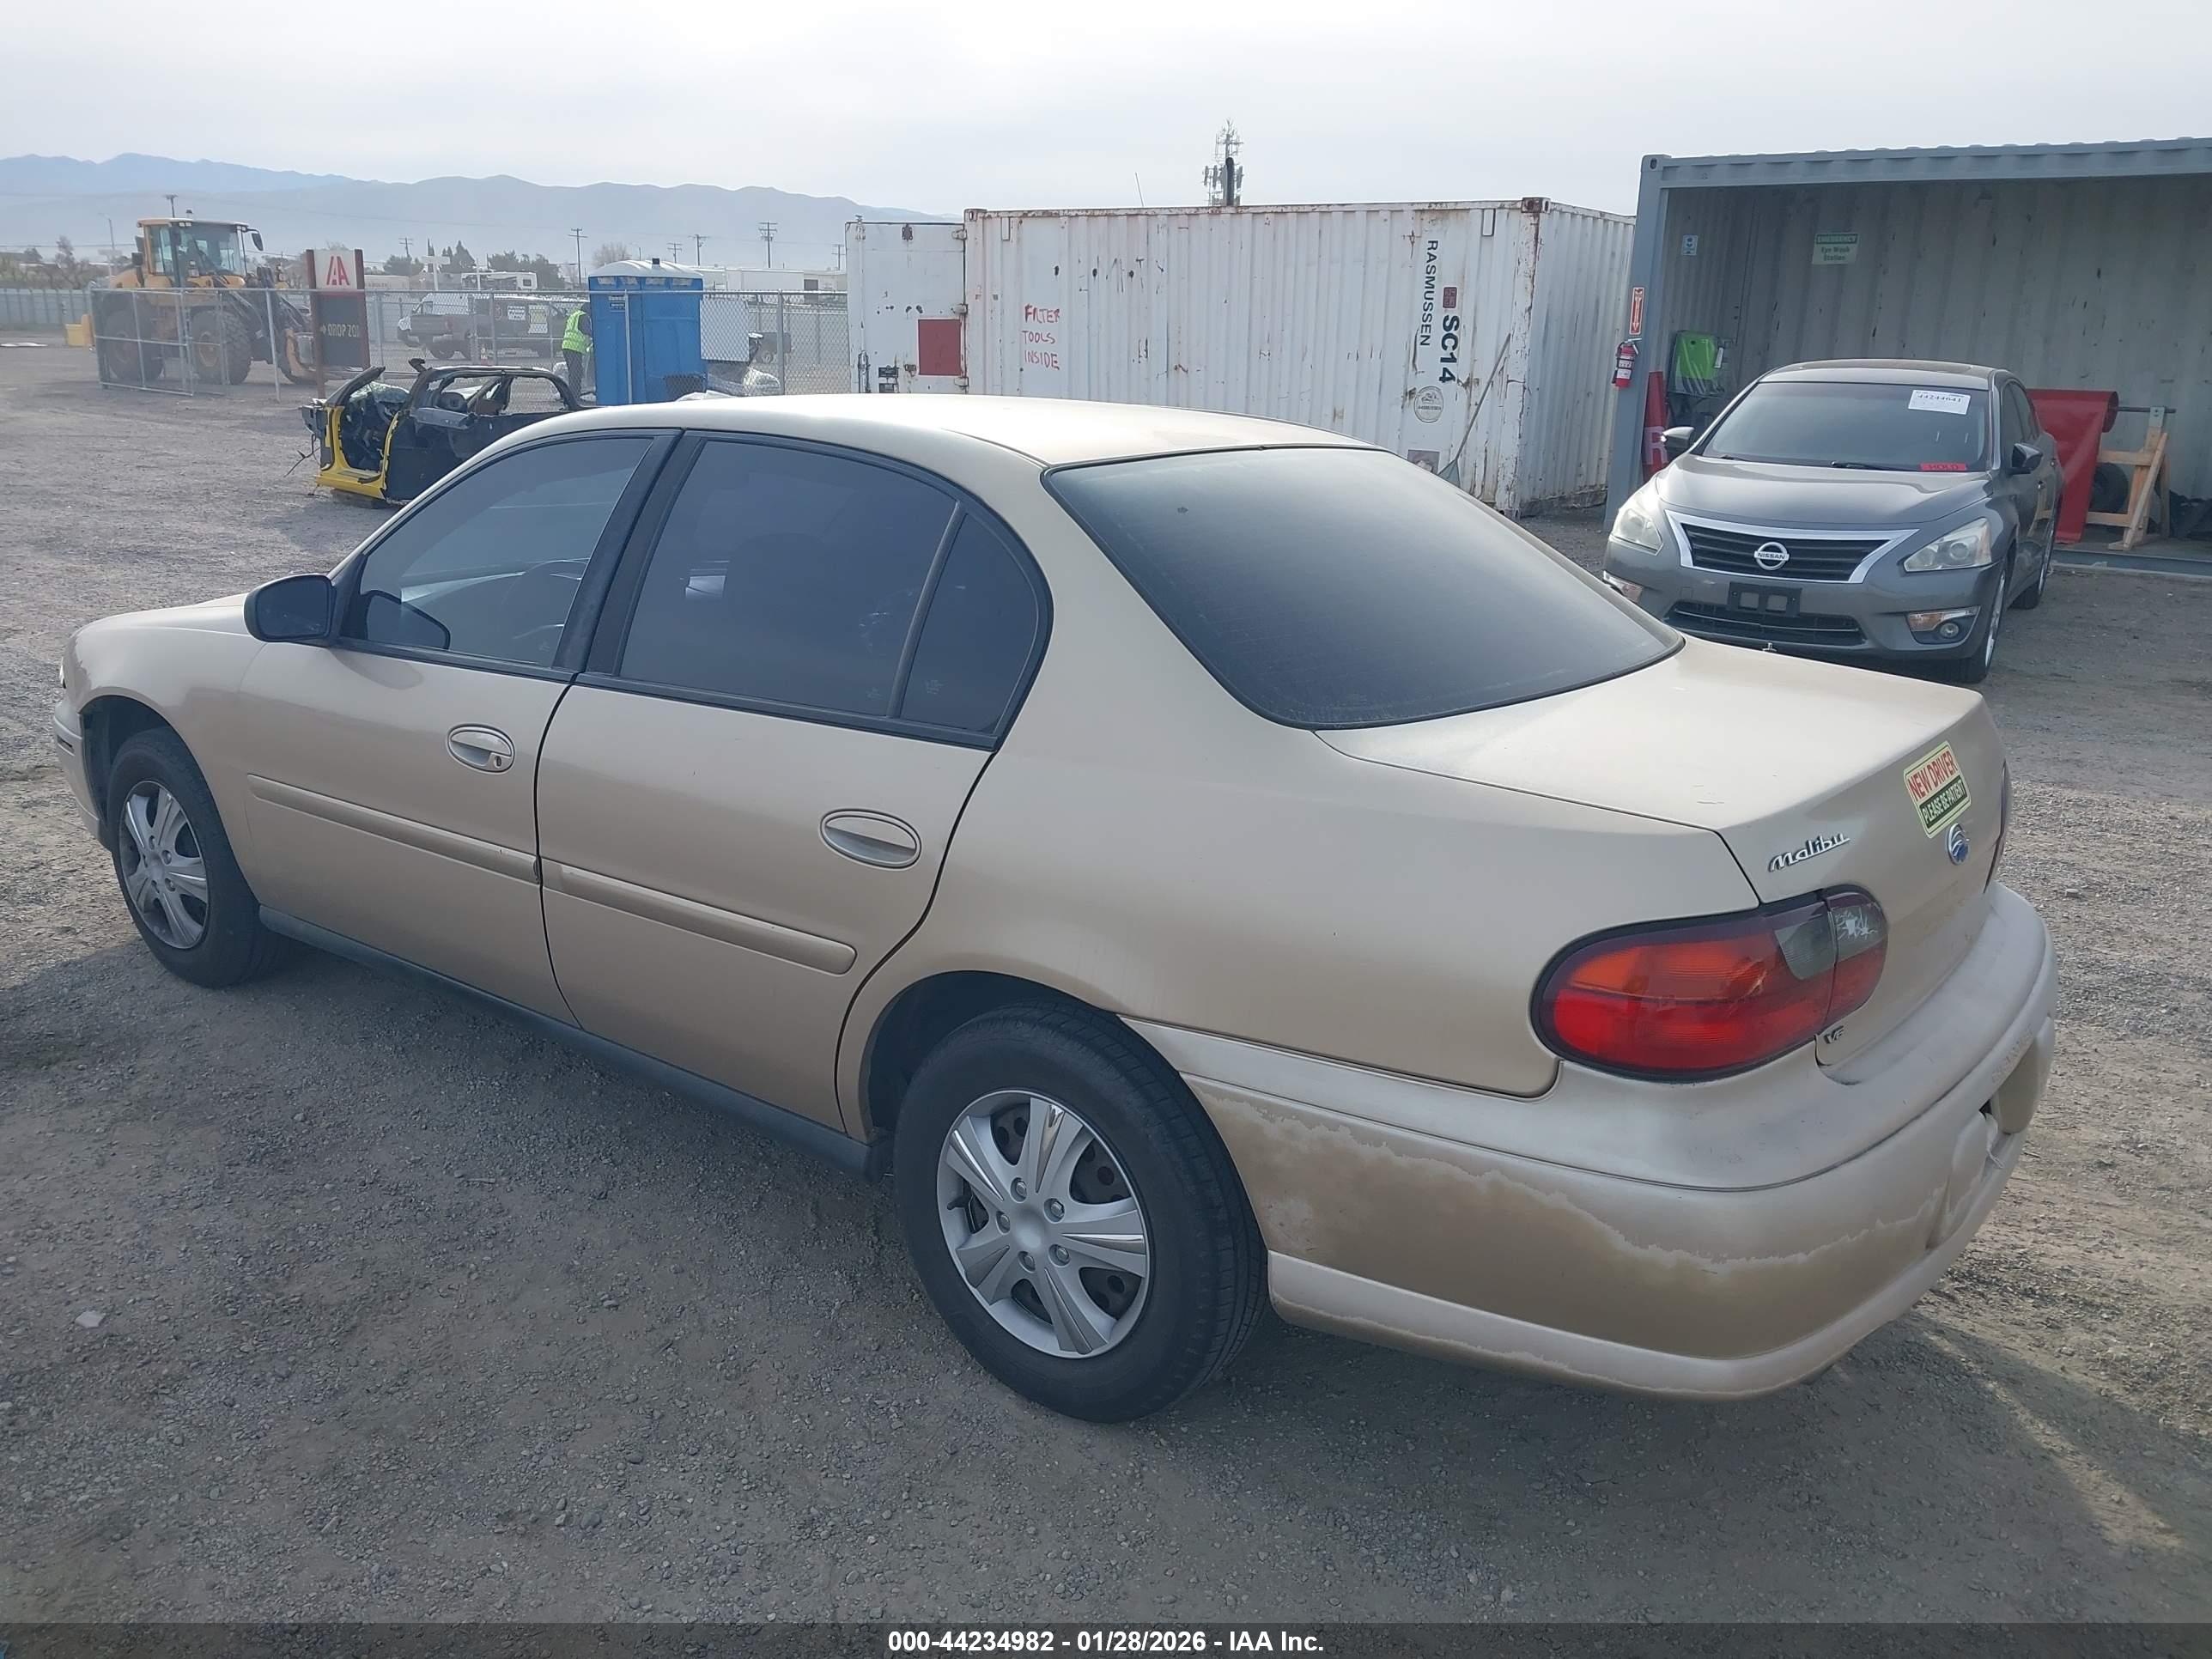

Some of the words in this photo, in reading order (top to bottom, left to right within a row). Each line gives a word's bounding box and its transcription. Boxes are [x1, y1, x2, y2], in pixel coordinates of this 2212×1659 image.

[1024, 304, 1060, 324] FILTER
[1419, 240, 1438, 346] RASMUSSEN
[1021, 330, 1055, 344] TOOLS
[1439, 314, 1460, 383] SC14
[1024, 349, 1060, 370] INSIDE
[1908, 768, 1932, 802] NEW
[1927, 750, 1958, 788] DRIVER
[1921, 796, 1943, 824] PLEASE
[1939, 791, 1949, 810] BE
[1945, 778, 1966, 805] PATIENT
[1768, 833, 1850, 872] Malibu
